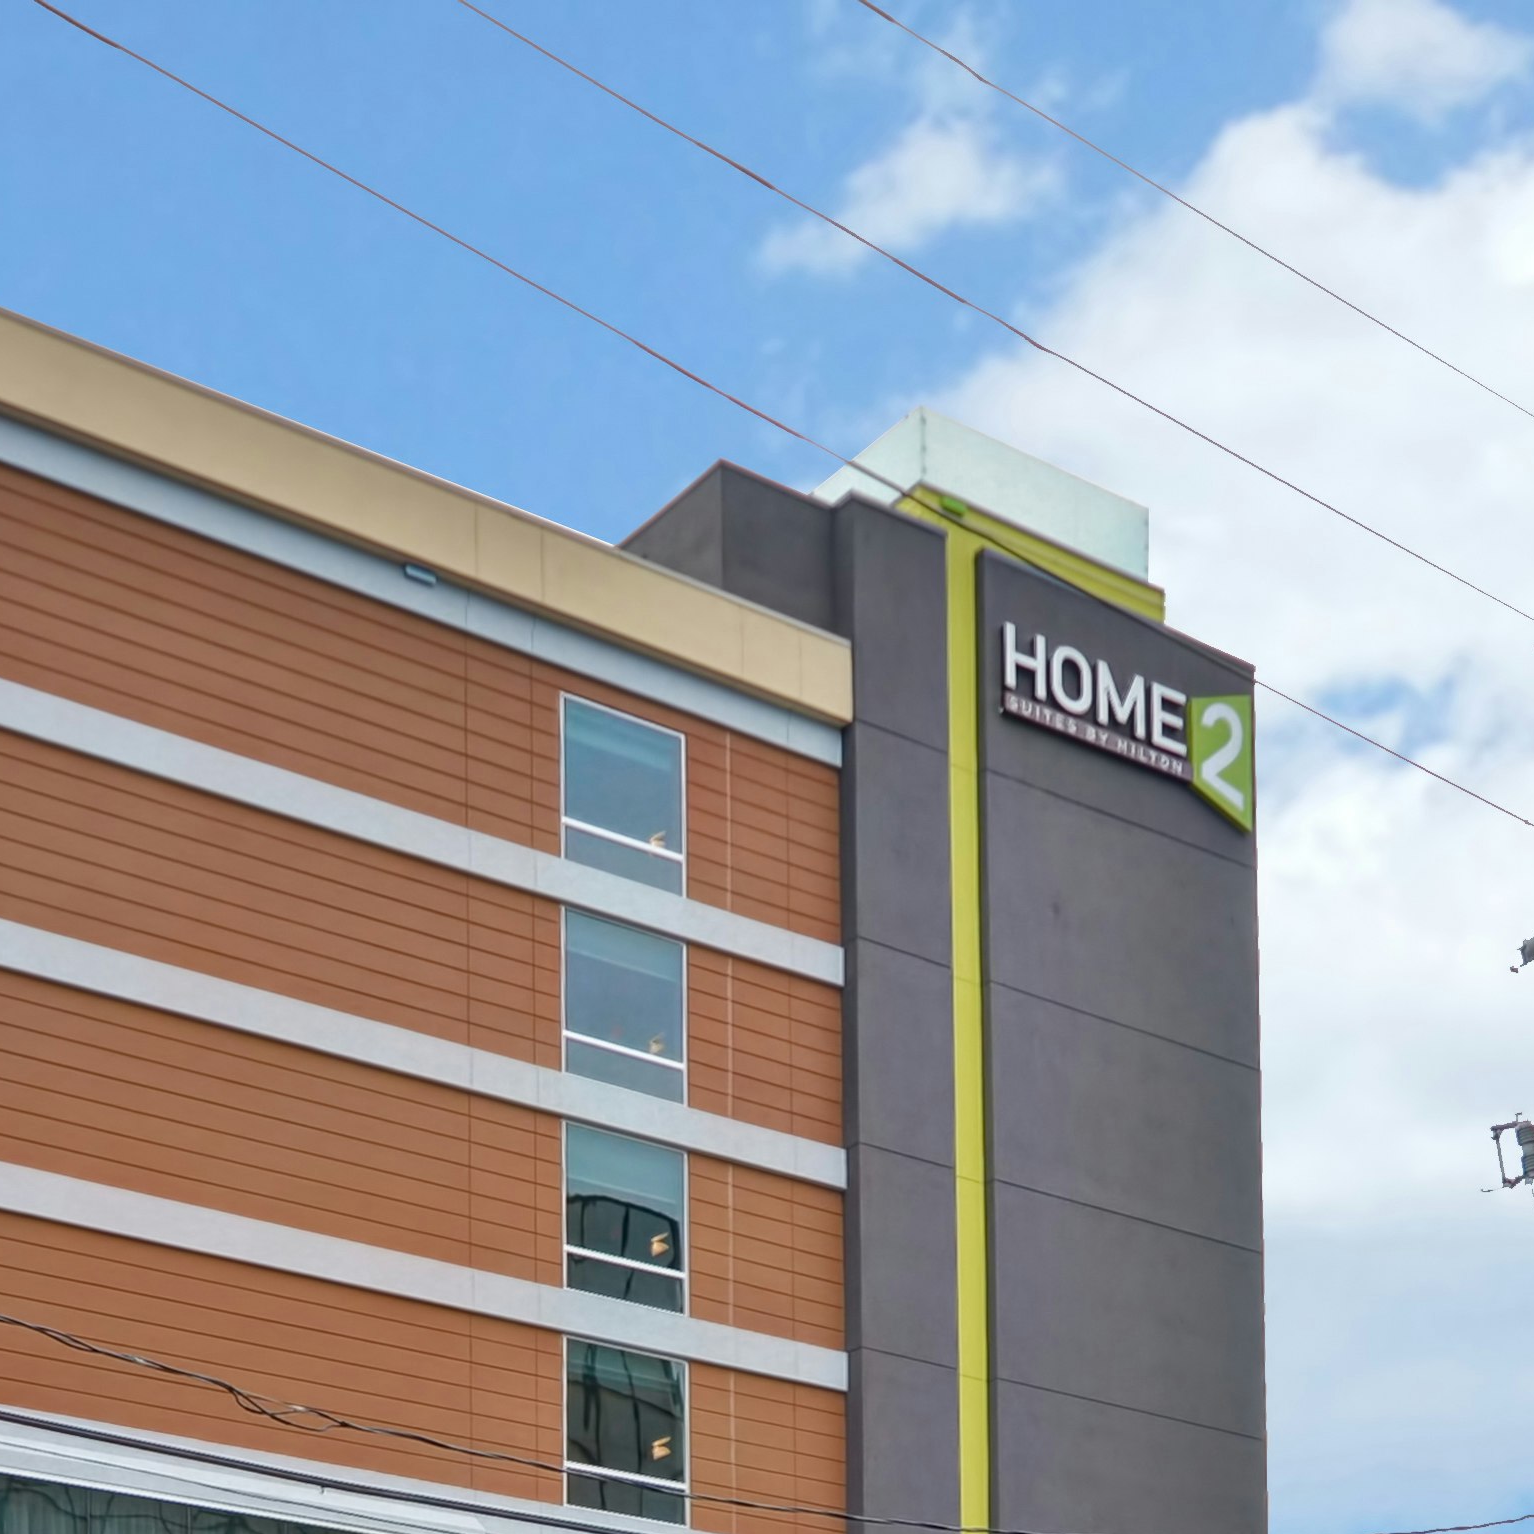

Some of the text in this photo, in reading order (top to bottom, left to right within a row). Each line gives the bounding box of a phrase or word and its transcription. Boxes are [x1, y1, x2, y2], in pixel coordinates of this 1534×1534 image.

[1003, 621, 1243, 812] HOME 2
[1009, 695, 1184, 775] SUITES BY HILTON
